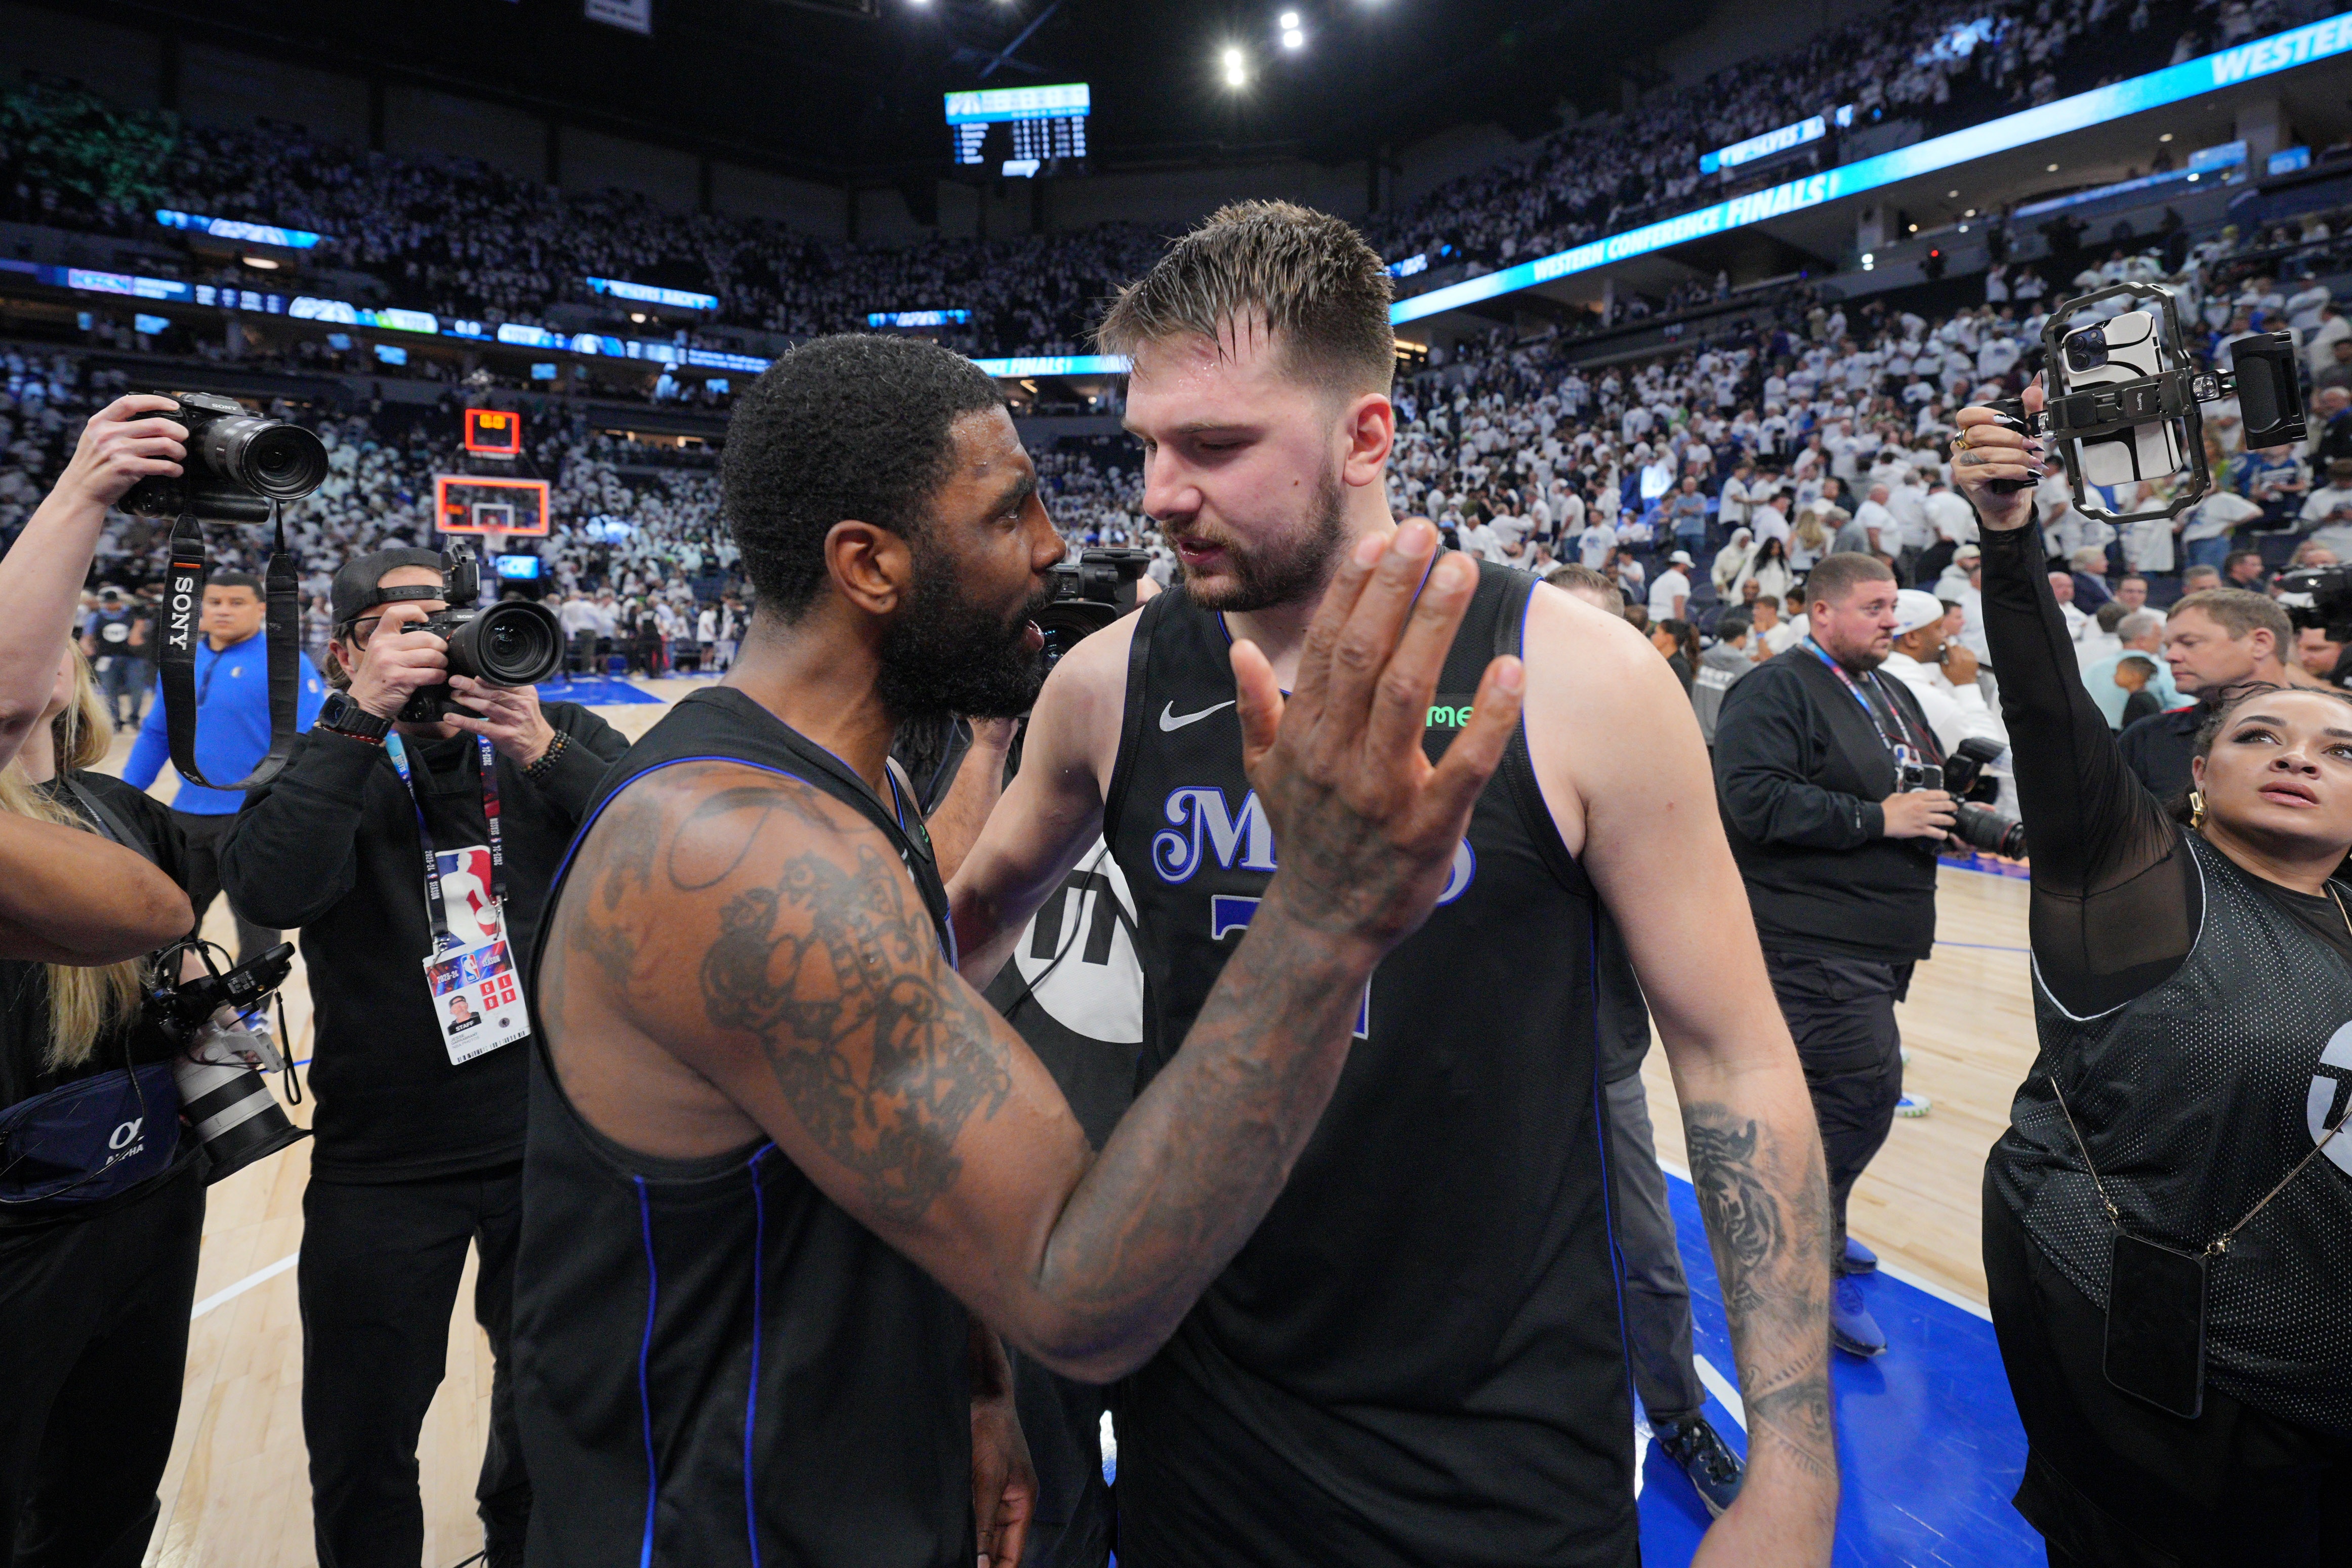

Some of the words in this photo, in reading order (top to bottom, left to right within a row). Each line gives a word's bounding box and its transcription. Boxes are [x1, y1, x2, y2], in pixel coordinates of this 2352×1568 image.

[1533, 242, 1605, 282] WESTERN
[1606, 205, 1720, 259] CONFERENCE
[1725, 180, 1826, 227] FINALS
[1010, 357, 1065, 375] FINALS
[169, 577, 193, 650] SONY
[482, 746, 492, 766] 2023-24
[489, 818, 500, 836] SEASON
[425, 850, 435, 871] 2023-24
[492, 845, 503, 866] 2023-24
[429, 881, 440, 900] SEASON
[437, 970, 459, 983] 2023-24
[482, 955, 501, 967] SEASON
[456, 1020, 474, 1031] STAFF
[450, 1034, 464, 1042] JESSE
